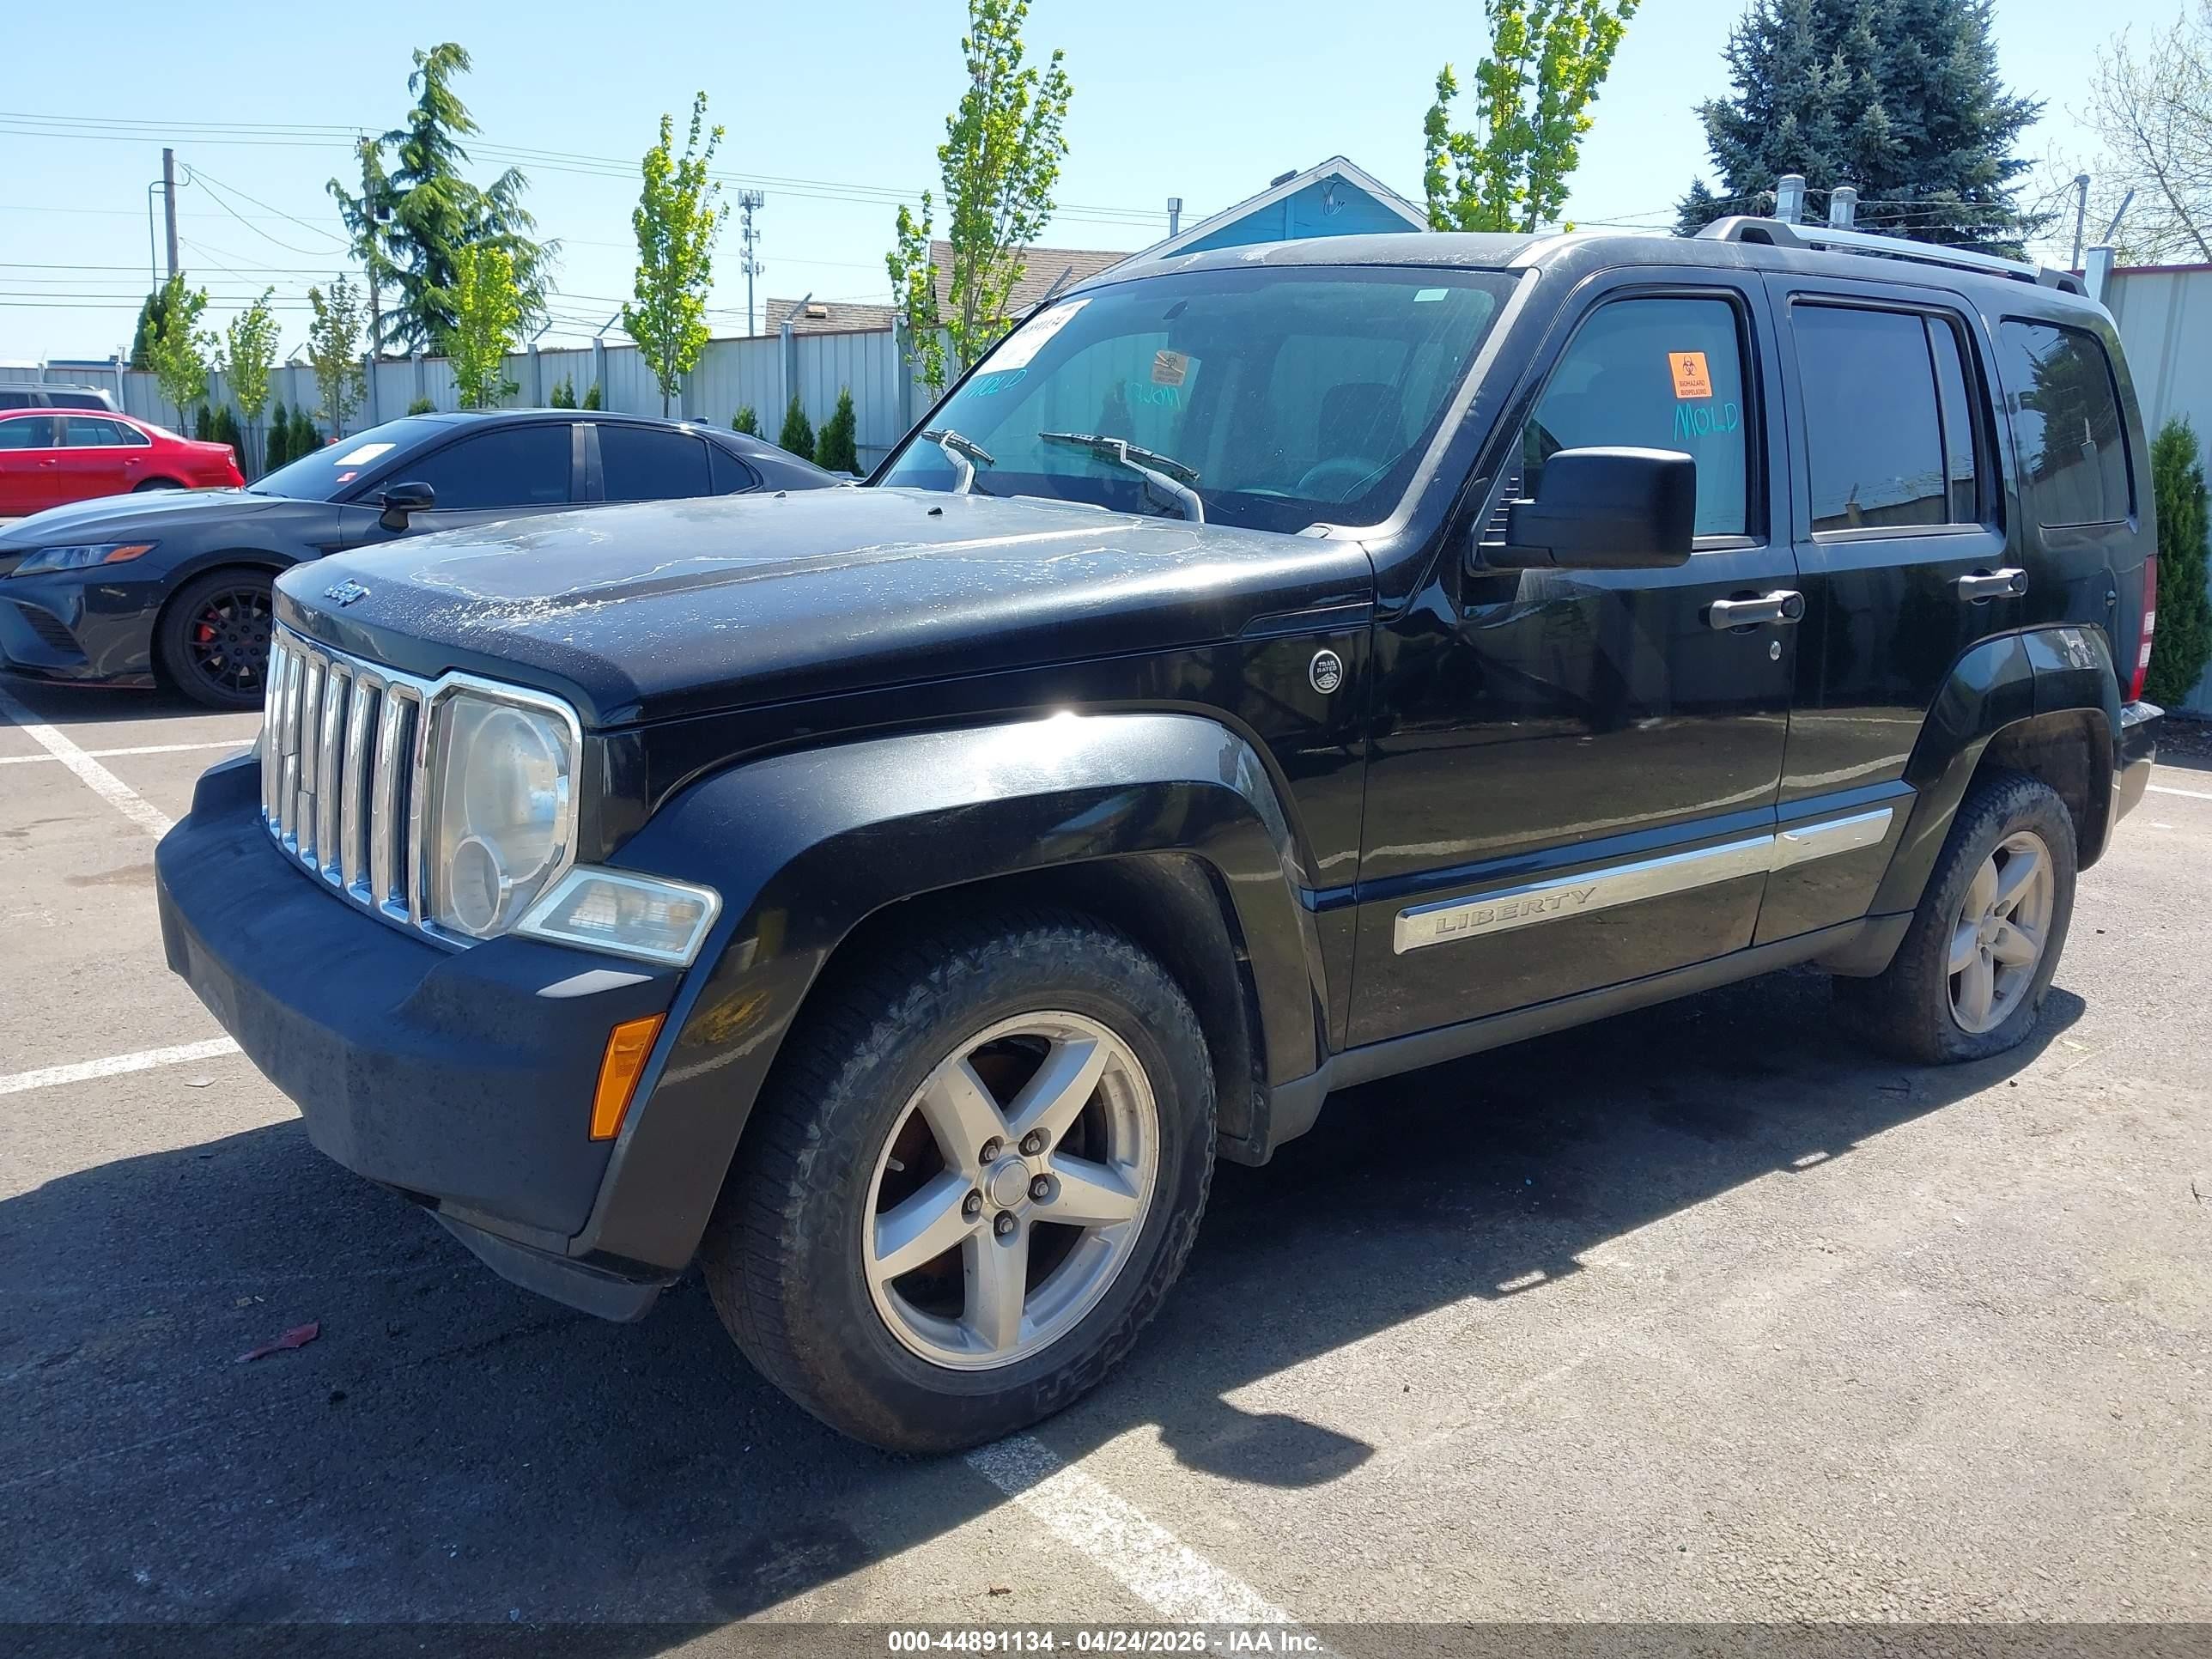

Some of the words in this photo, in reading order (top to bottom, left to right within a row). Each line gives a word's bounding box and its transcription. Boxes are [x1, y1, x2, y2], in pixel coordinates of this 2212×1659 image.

[963, 369, 1028, 398] MOLD
[1674, 402, 1739, 441] MOLD
[324, 577, 369, 607] Jeep
[1318, 659, 1336, 668] TRAIL
[1434, 886, 1596, 934] LIBERTY
